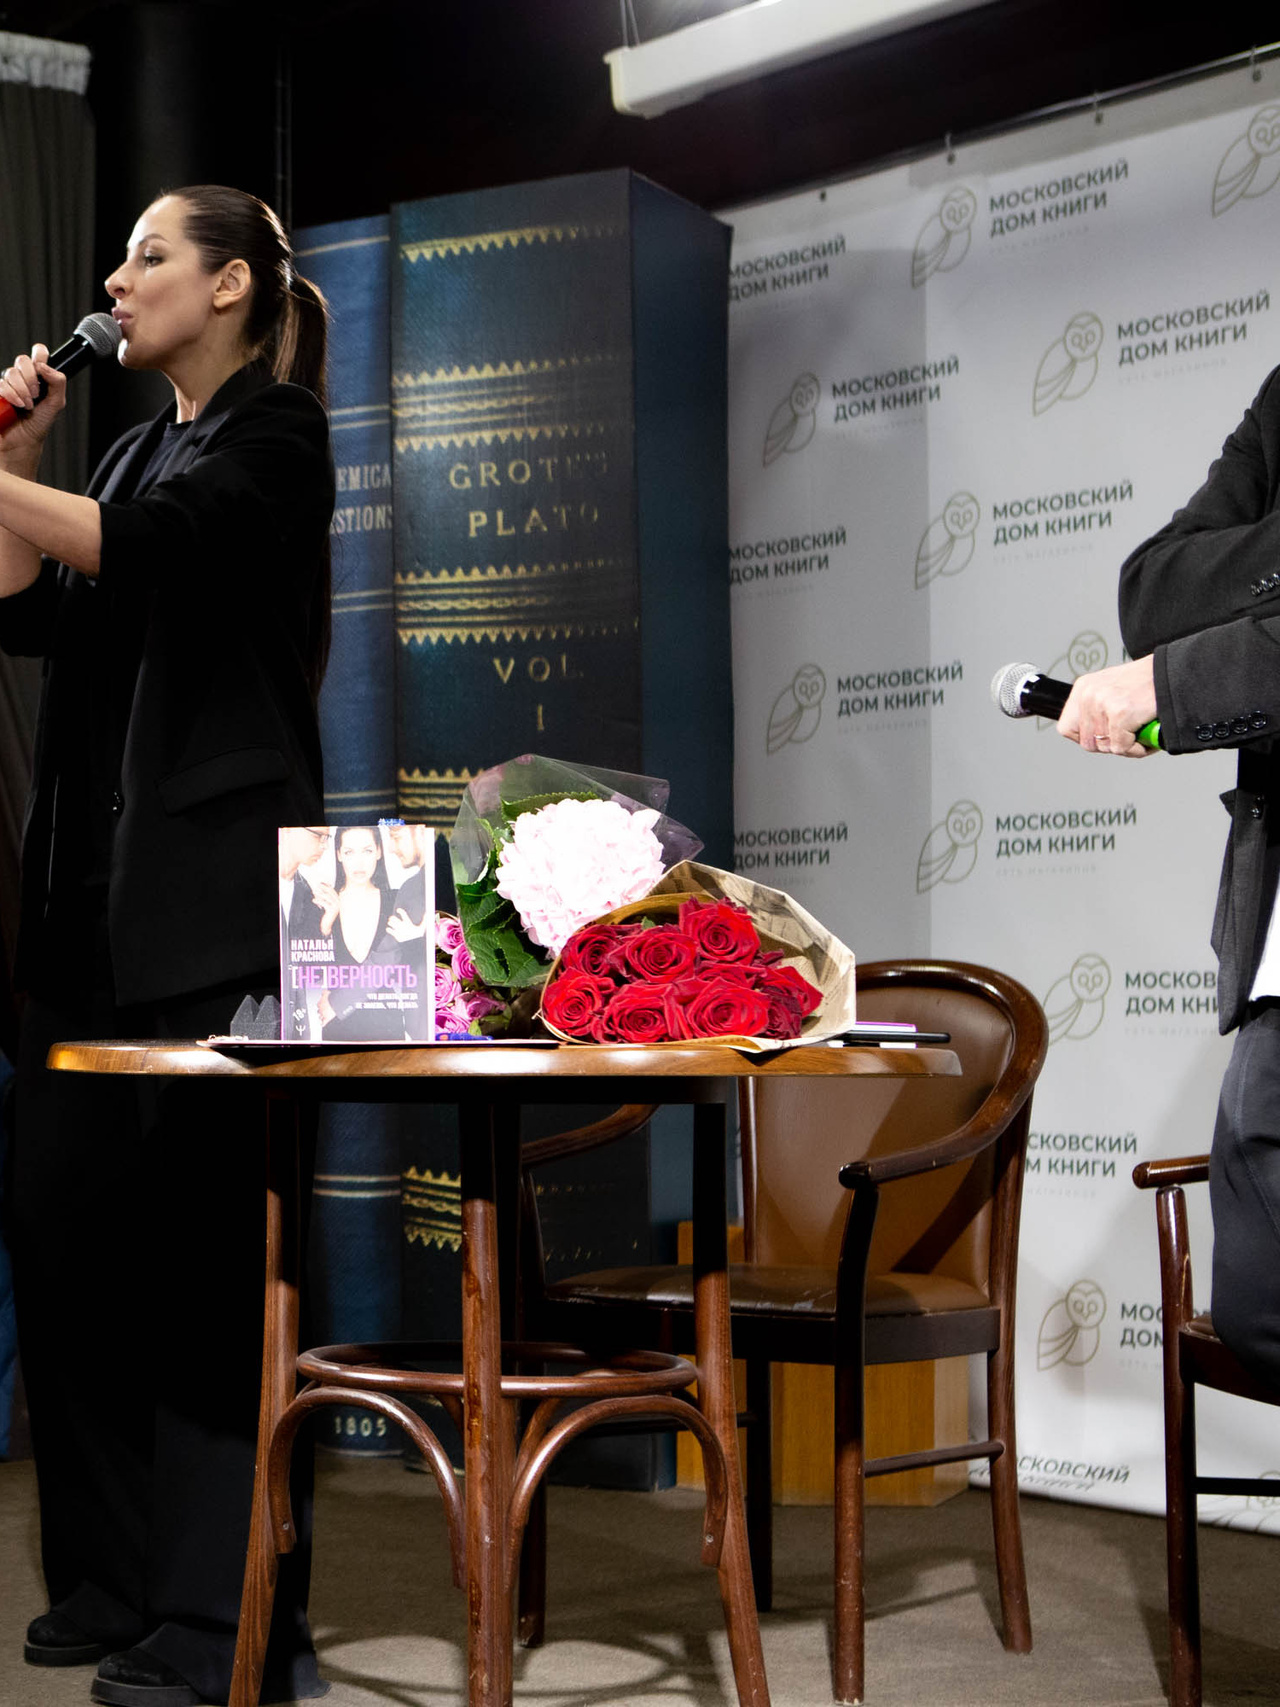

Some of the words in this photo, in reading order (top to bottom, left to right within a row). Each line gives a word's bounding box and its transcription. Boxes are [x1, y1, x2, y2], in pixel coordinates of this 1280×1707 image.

[990, 158, 1129, 213] МОСКОВСКИЙ
[990, 209, 1036, 239] ДОМ
[1042, 191, 1107, 223] КНИГИ
[772, 262, 829, 292] КНИГИ
[1117, 288, 1270, 340] МОСКОВСКИЙ
[1119, 339, 1168, 368] ДОМ
[1175, 322, 1247, 353] КНИГИ
[832, 354, 960, 399] МОСКОВСКИЙ
[834, 398, 876, 423] ДОМ
[881, 384, 941, 412] КНИГИ
[993, 479, 1134, 521] МОСКОВСКИЙ
[730, 525, 847, 561] МОСКОВСКИЙ
[994, 521, 1039, 547] ДОМ
[1046, 511, 1112, 537] КНИГИ
[730, 563, 769, 586] ДОМ
[774, 554, 829, 578] КНИГИ
[837, 659, 963, 694] МОСКОВСКИЙ
[837, 695, 879, 718] ДОМ
[884, 689, 944, 711] КНИГИ
[996, 803, 1137, 833] МОСКОВСКИЙ
[734, 821, 848, 848] МОСКОВСКИЙ
[996, 837, 1042, 859] ДОМ
[1048, 833, 1115, 854] КНИГИ
[734, 850, 769, 872] ДОМ
[775, 848, 830, 868] КНИГИ
[291, 939, 334, 951] НАТАЛЬЯ
[291, 950, 335, 962] КРАСНОВА
[291, 964, 418, 989] [НЕ]ВЕРНОСТЬ
[1125, 971, 1217, 990] МОСКОВ
[1125, 996, 1175, 1017] ДОМ
[1027, 1131, 1138, 1155] СКОВСКИЙ
[1048, 1157, 1116, 1178] КНИГИ
[334, 1415, 387, 1438] 1805
[1019, 1455, 1131, 1484] СКОВСКИЙ
